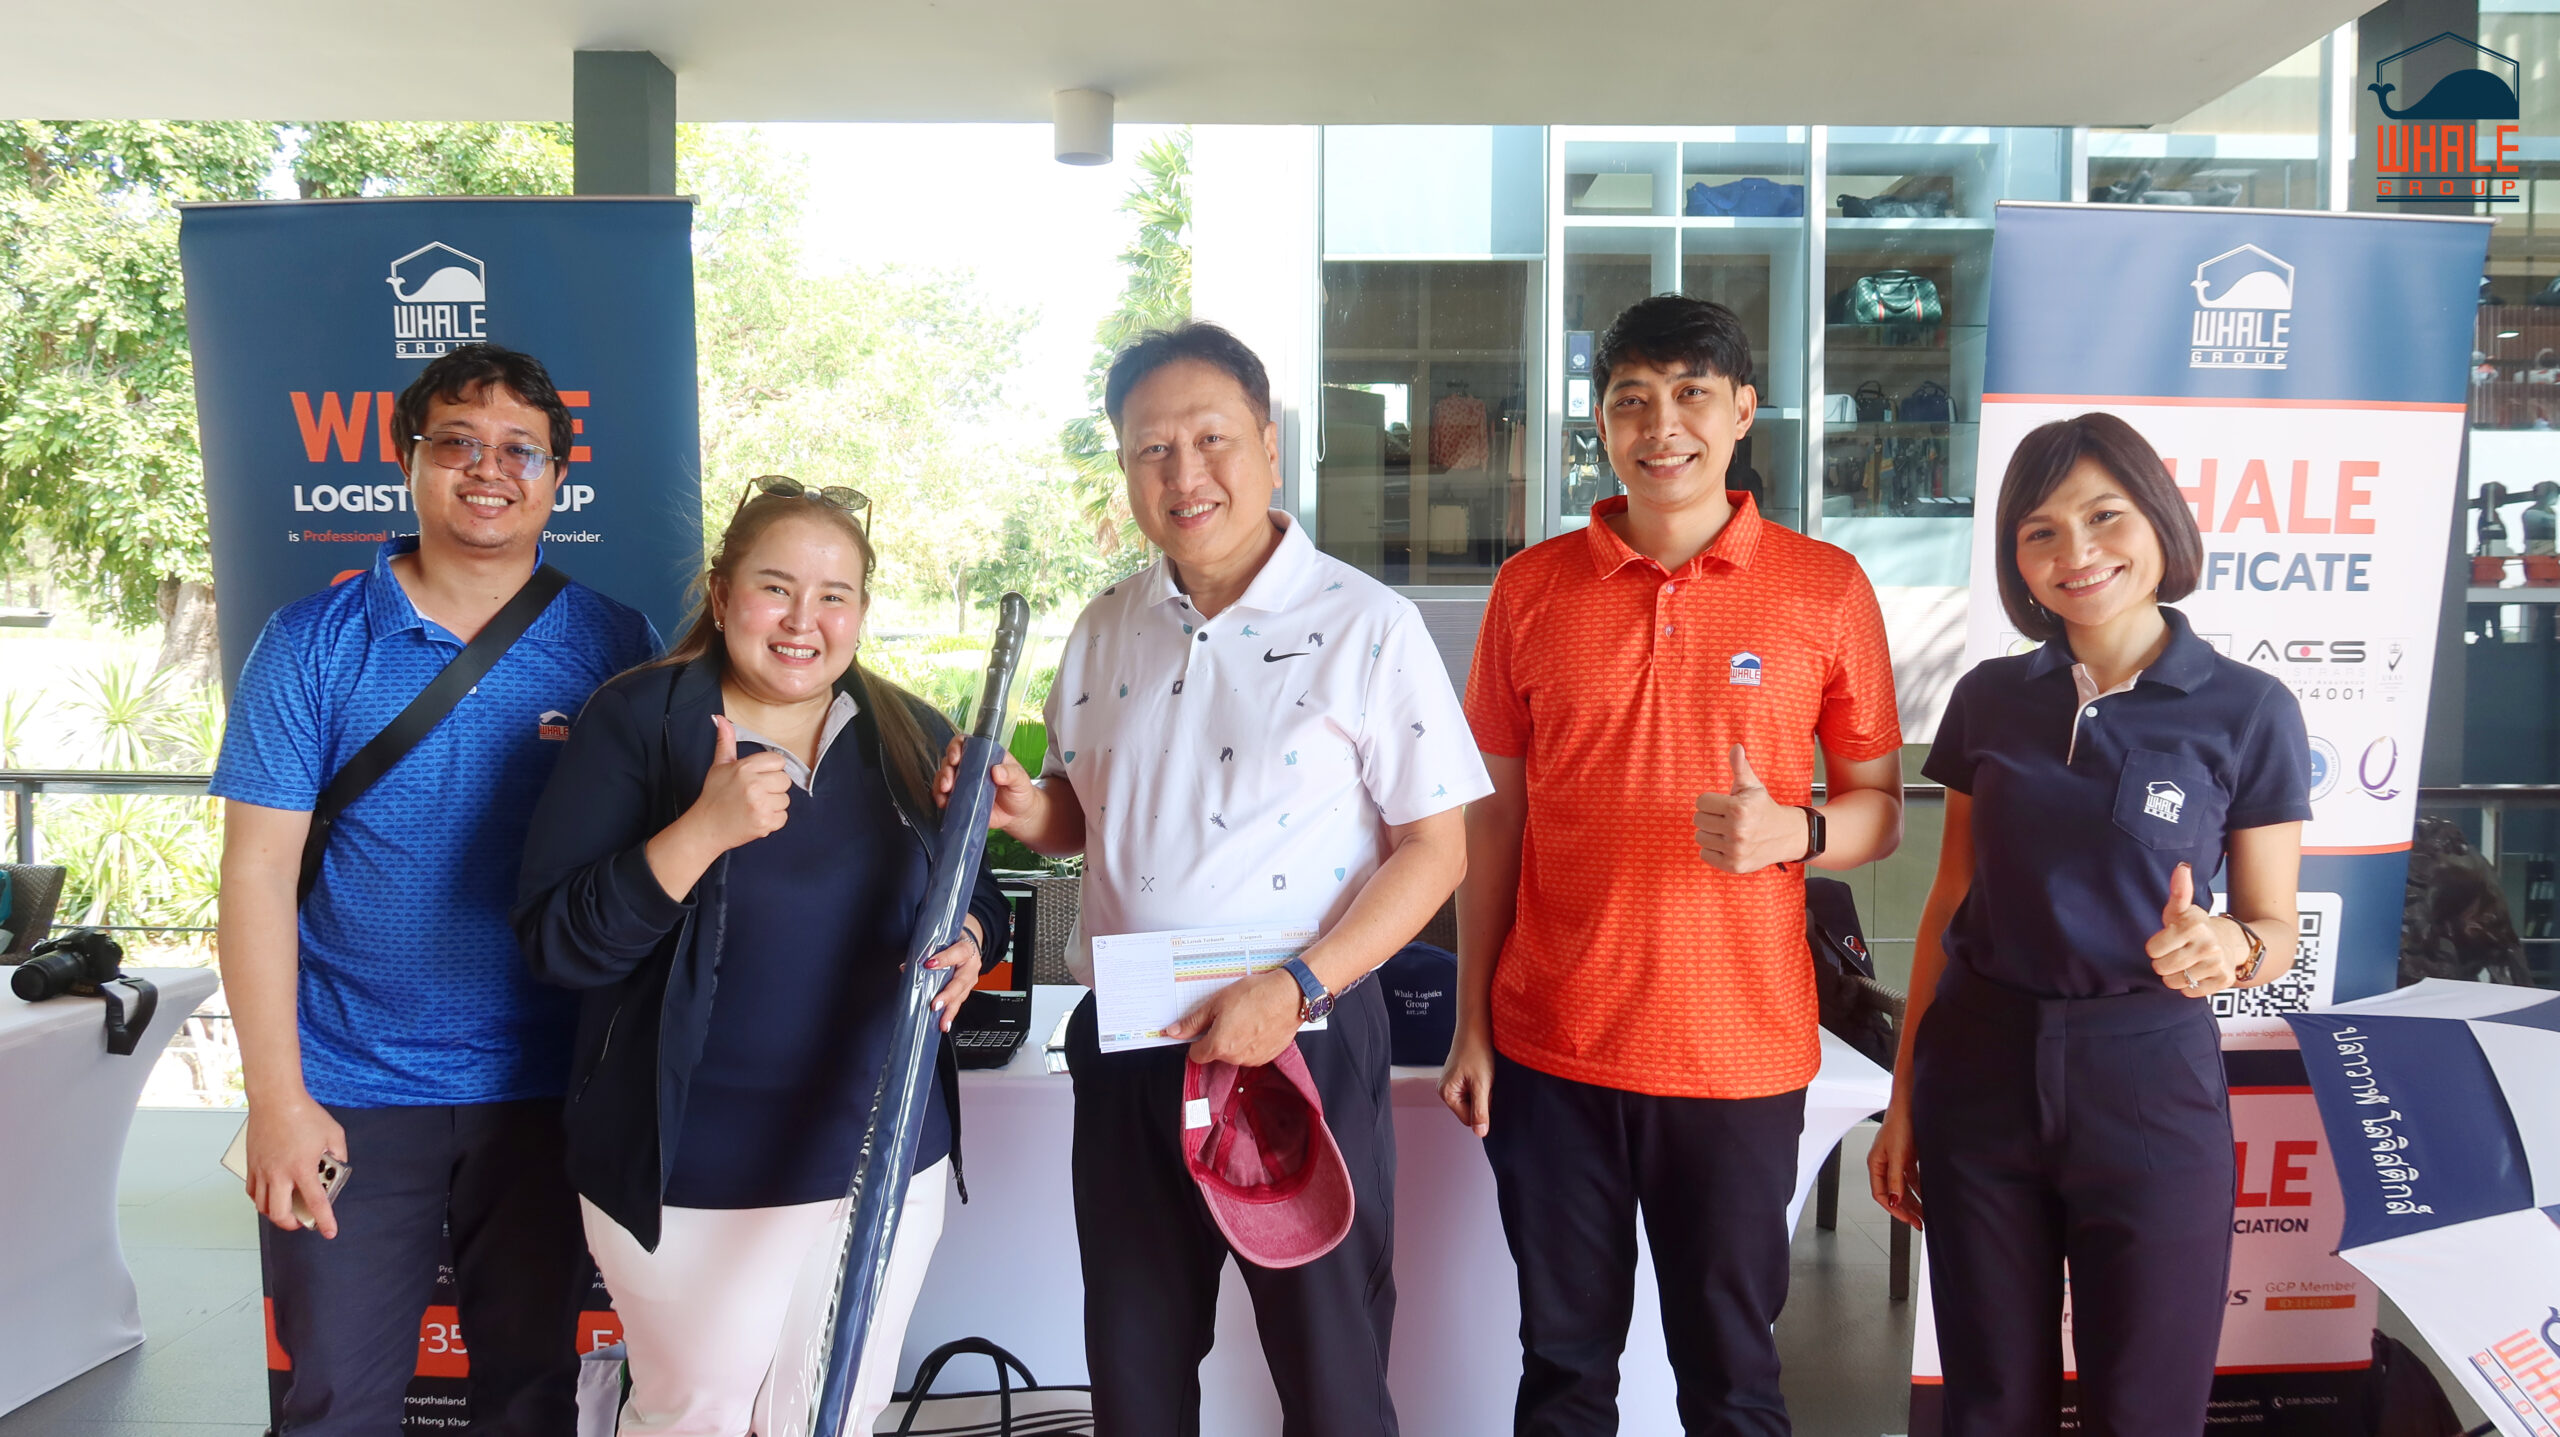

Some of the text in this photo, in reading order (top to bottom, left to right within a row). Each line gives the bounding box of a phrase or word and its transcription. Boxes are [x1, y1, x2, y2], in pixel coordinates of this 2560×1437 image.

[393, 304, 487, 338] WHALE
[2192, 311, 2291, 348] WHALE
[2191, 352, 2286, 364] GROUP
[294, 484, 416, 512] LOGIST
[2162, 458, 2380, 534] HALE
[288, 530, 300, 542] is
[303, 530, 388, 542] Professional
[542, 530, 604, 543] Provider.
[2197, 551, 2373, 591] FICATE
[2247, 640, 2367, 663] ACS
[1730, 668, 1761, 680] WHALE
[2146, 795, 2182, 817] WHALE
[1394, 989, 1443, 1000] Whale Logistics
[1405, 999, 1430, 1009] Group
[2332, 1026, 2435, 1216] ปลาวาฬ โลจิสติกส์
[2233, 1218, 2309, 1234] CIATION
[2265, 1280, 2356, 1293] GCP Member
[403, 1395, 467, 1406] roupthailand
[417, 1416, 445, 1428] Nong
